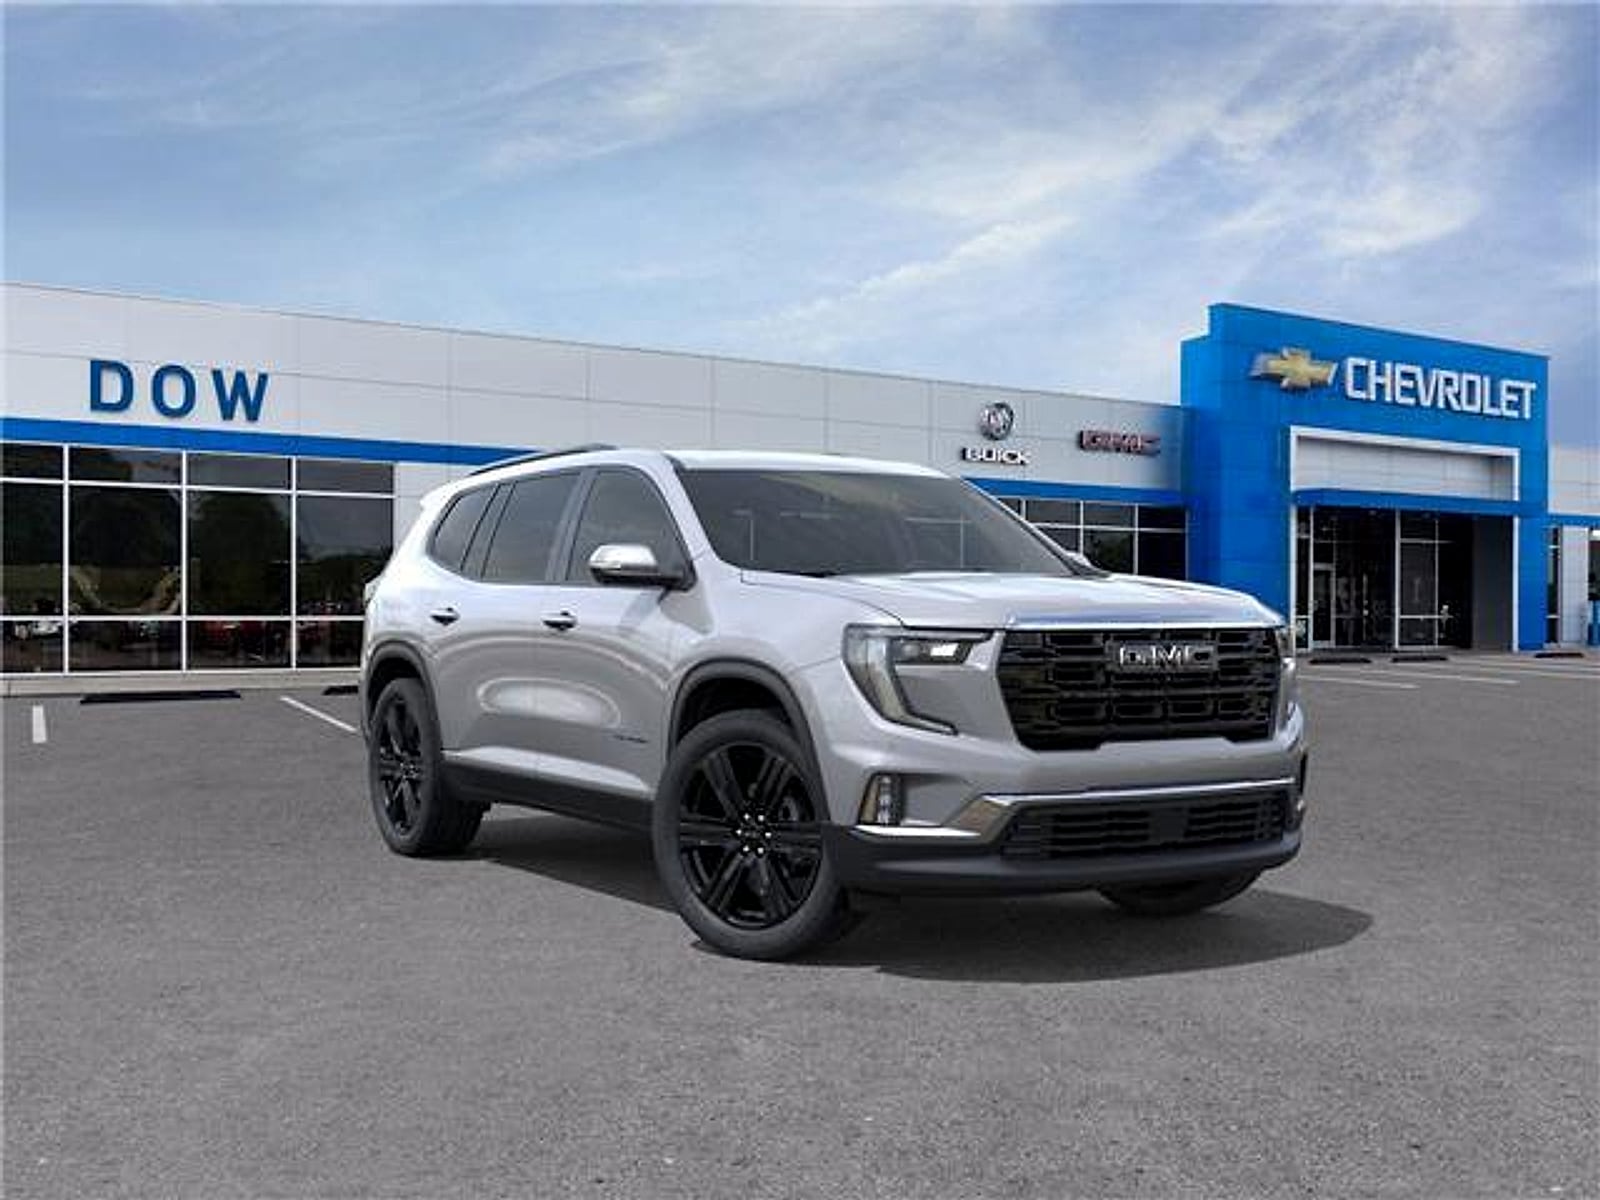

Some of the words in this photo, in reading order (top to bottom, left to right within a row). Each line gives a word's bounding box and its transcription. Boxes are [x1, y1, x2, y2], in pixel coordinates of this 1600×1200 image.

[90, 359, 269, 421] DOW
[1345, 356, 1537, 420] CHEVROLET
[961, 447, 1031, 465] BUICK
[1118, 642, 1215, 672] GMC
